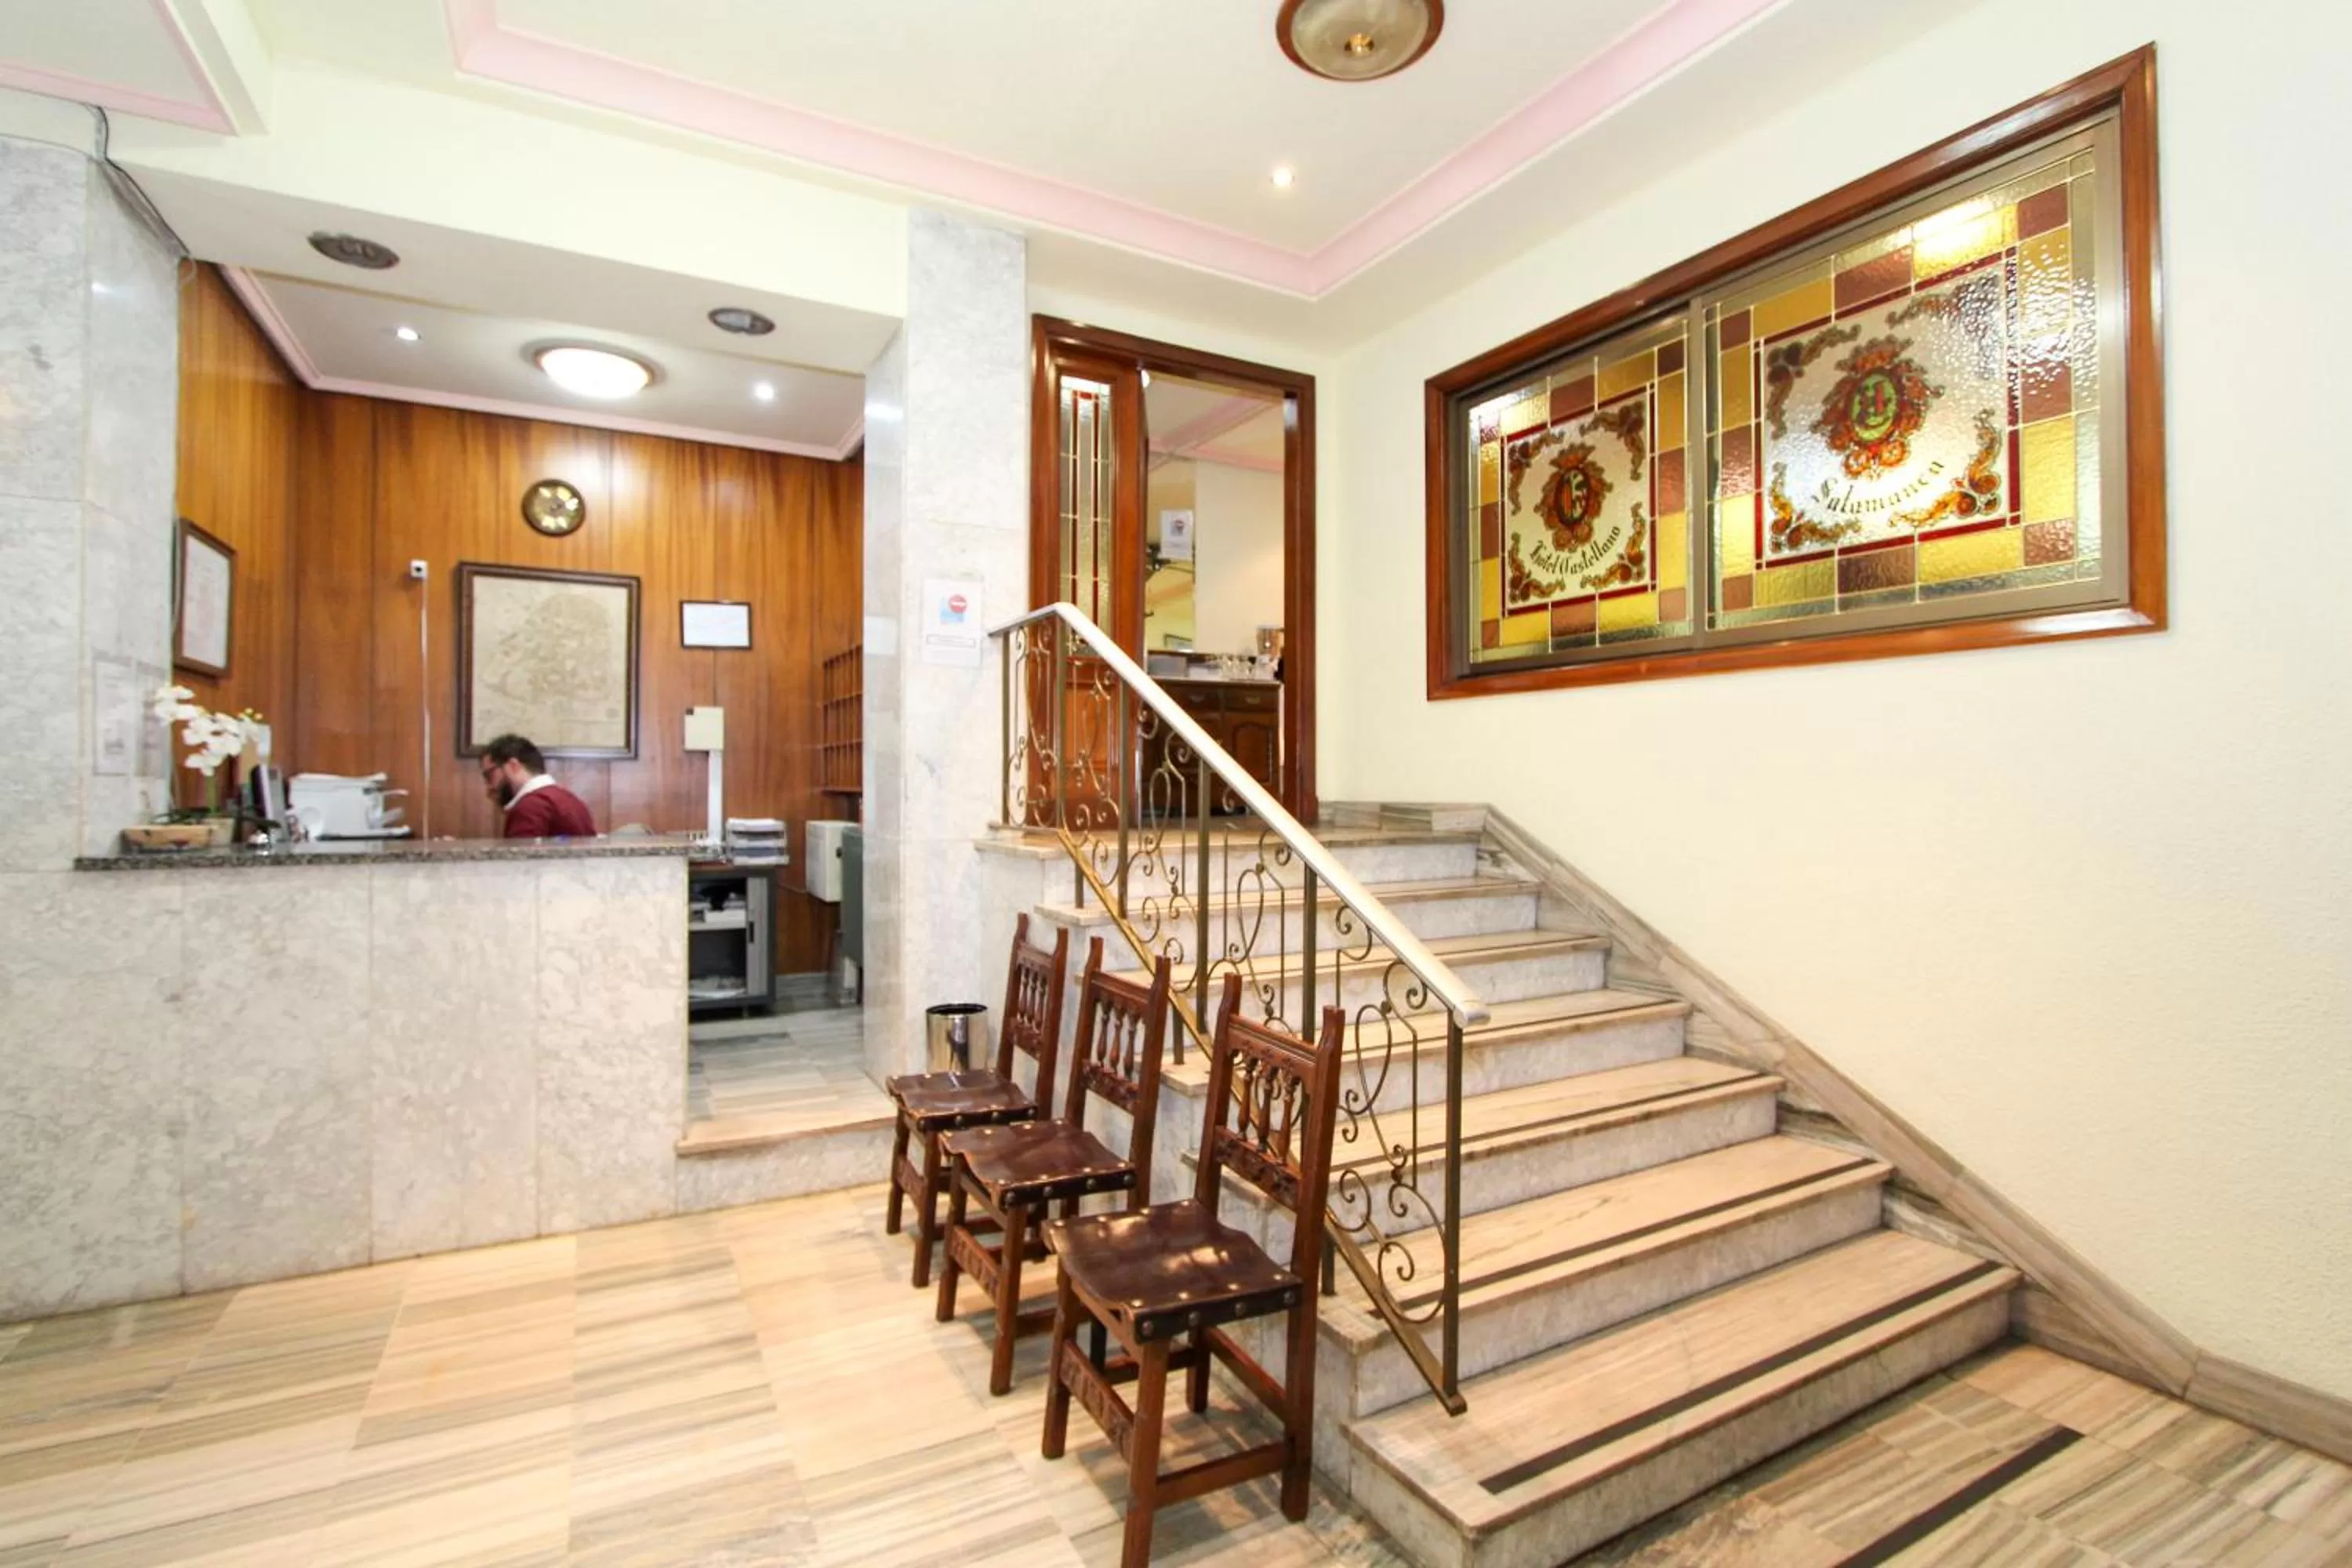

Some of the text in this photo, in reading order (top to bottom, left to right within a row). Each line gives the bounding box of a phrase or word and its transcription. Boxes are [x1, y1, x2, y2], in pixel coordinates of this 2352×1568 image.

[1811, 460, 1944, 514] Salamanca
[1530, 526, 1621, 575] Hotel Castellano
